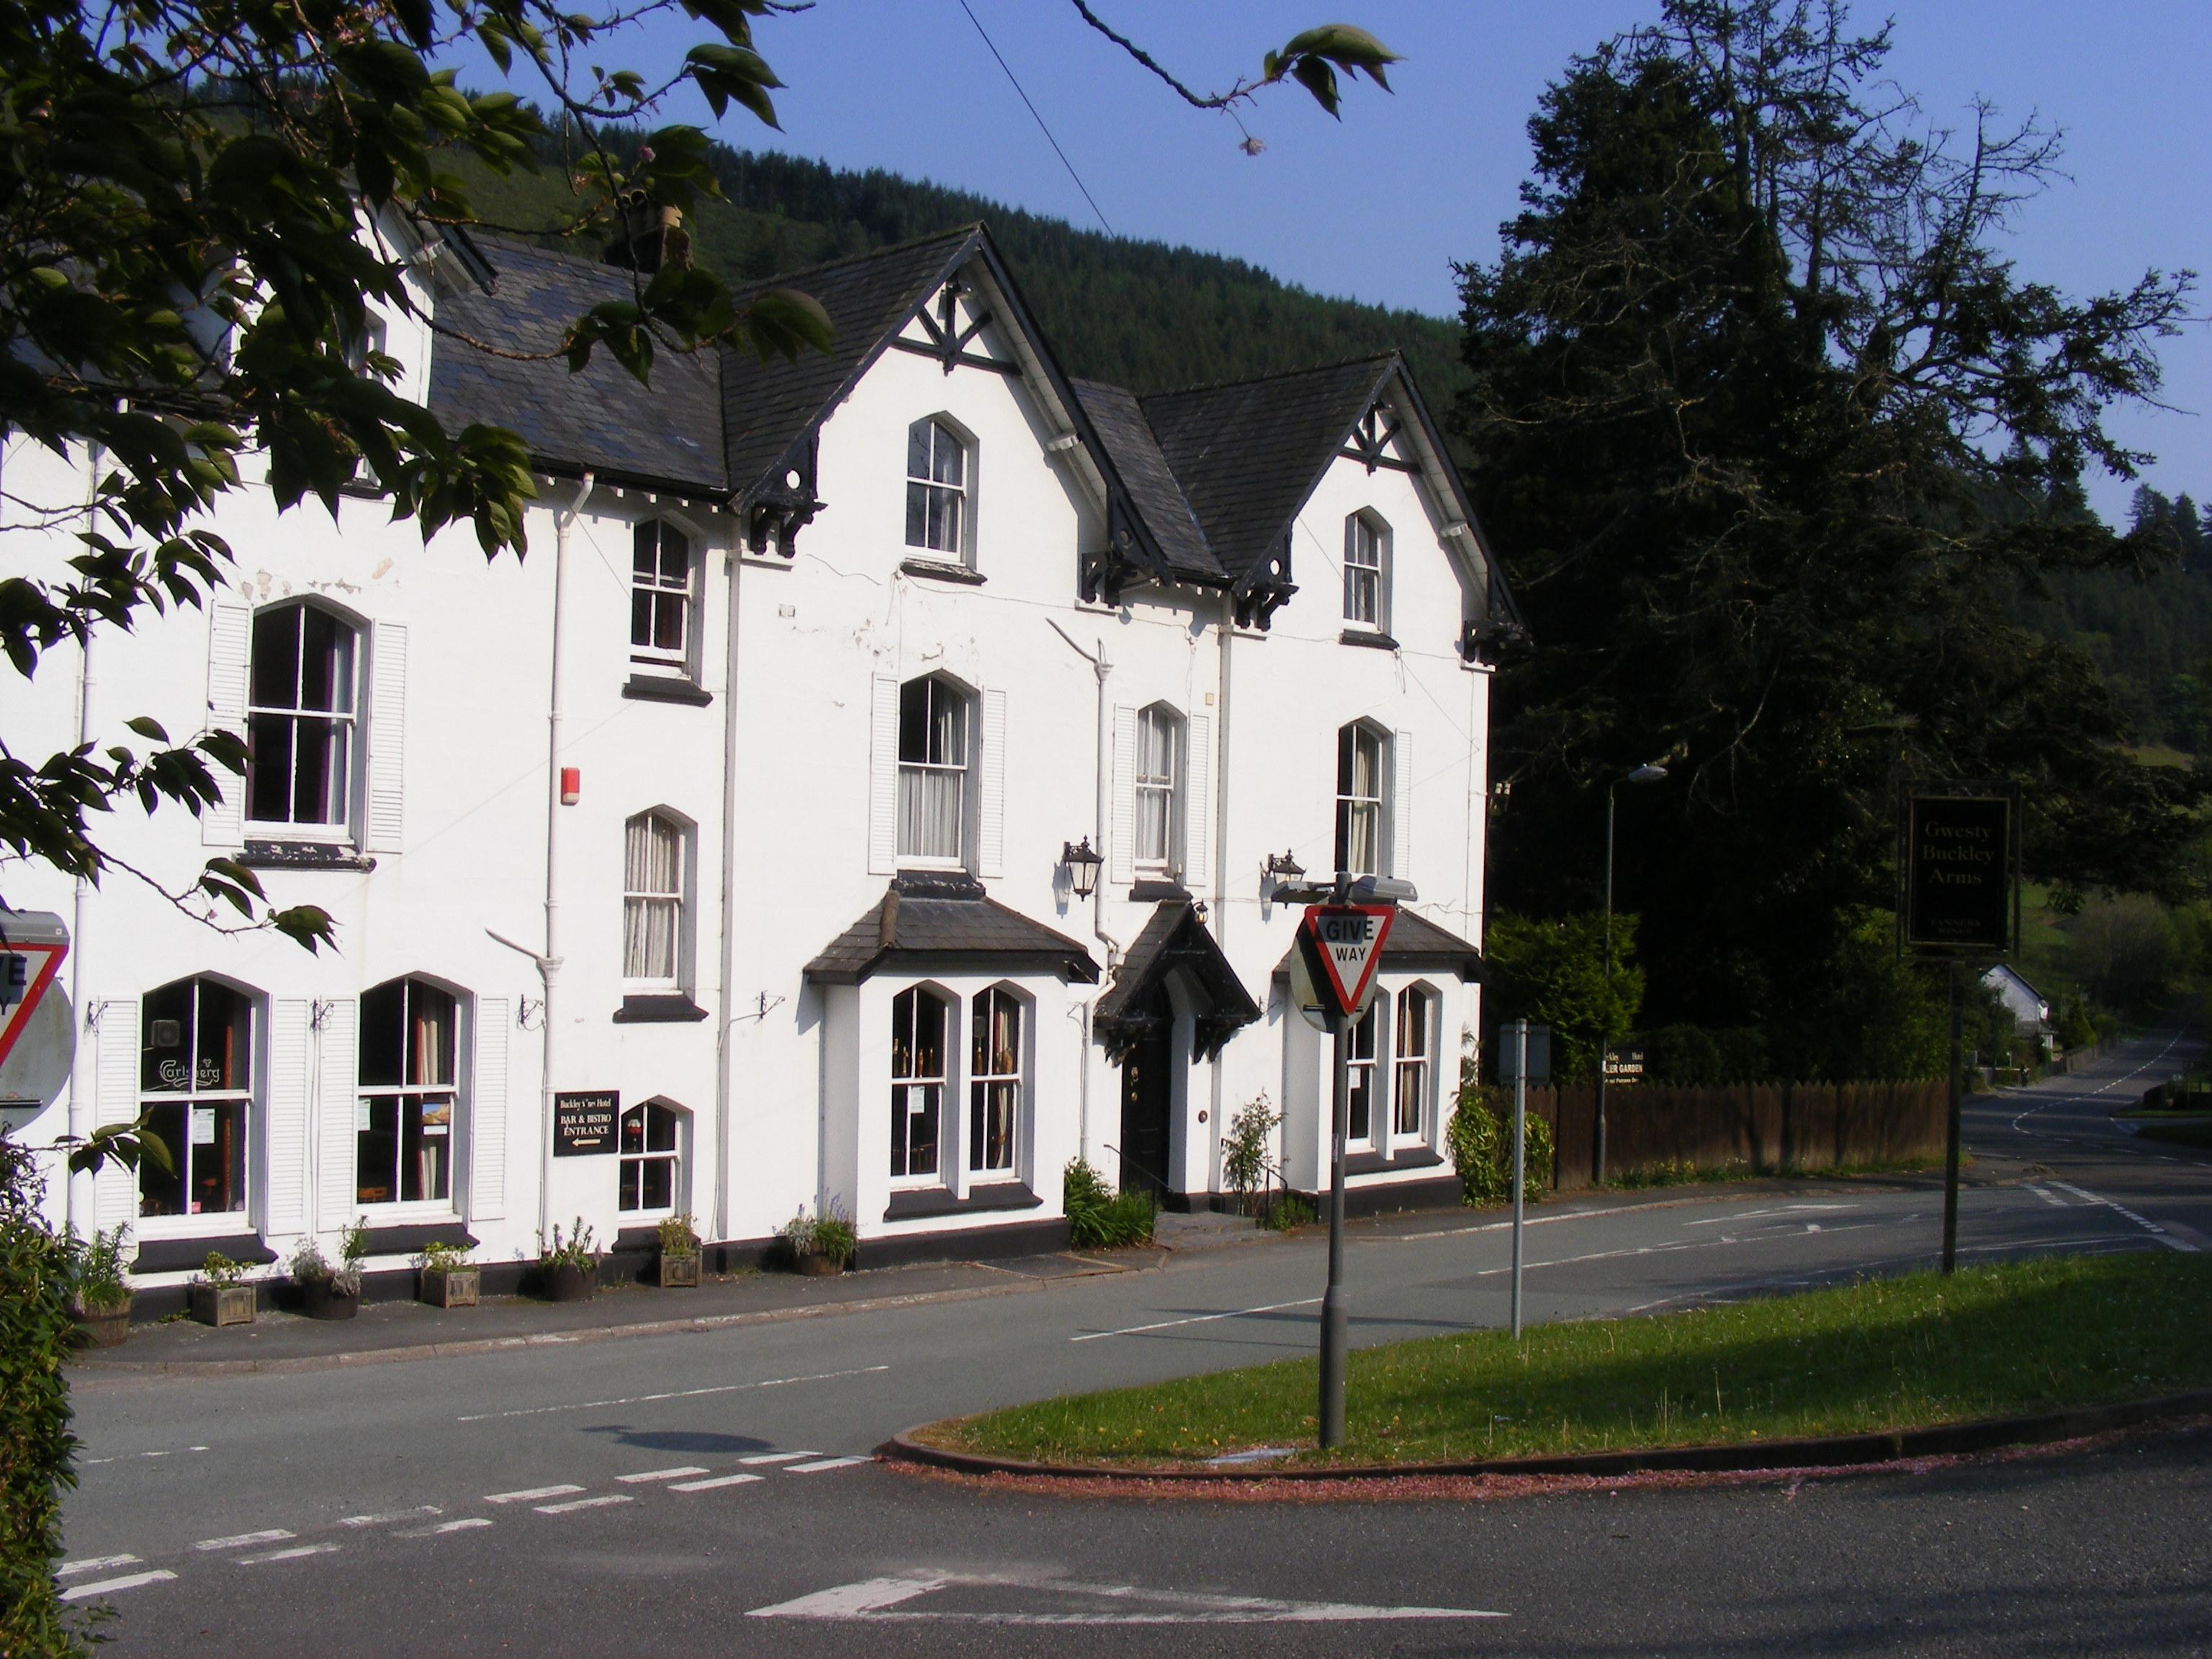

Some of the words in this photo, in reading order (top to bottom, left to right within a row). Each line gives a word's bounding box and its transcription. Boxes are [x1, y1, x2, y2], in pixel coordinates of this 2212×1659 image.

[1925, 820, 1992, 842] Gwesty
[1923, 844, 1995, 865] Buckley
[1928, 868, 1982, 885] Arms
[1326, 920, 1374, 940] GIVE
[1336, 948, 1366, 961] WAY
[159, 1059, 220, 1083] Carlserg
[1619, 1064, 1643, 1073] GARDEN
[560, 1098, 580, 1111] Buckley
[597, 1097, 611, 1107] Hotel
[560, 1115, 577, 1124] BAR
[578, 1114, 585, 1124] &
[587, 1113, 612, 1123] BISTRO
[564, 1125, 609, 1136] ENTRANCE
